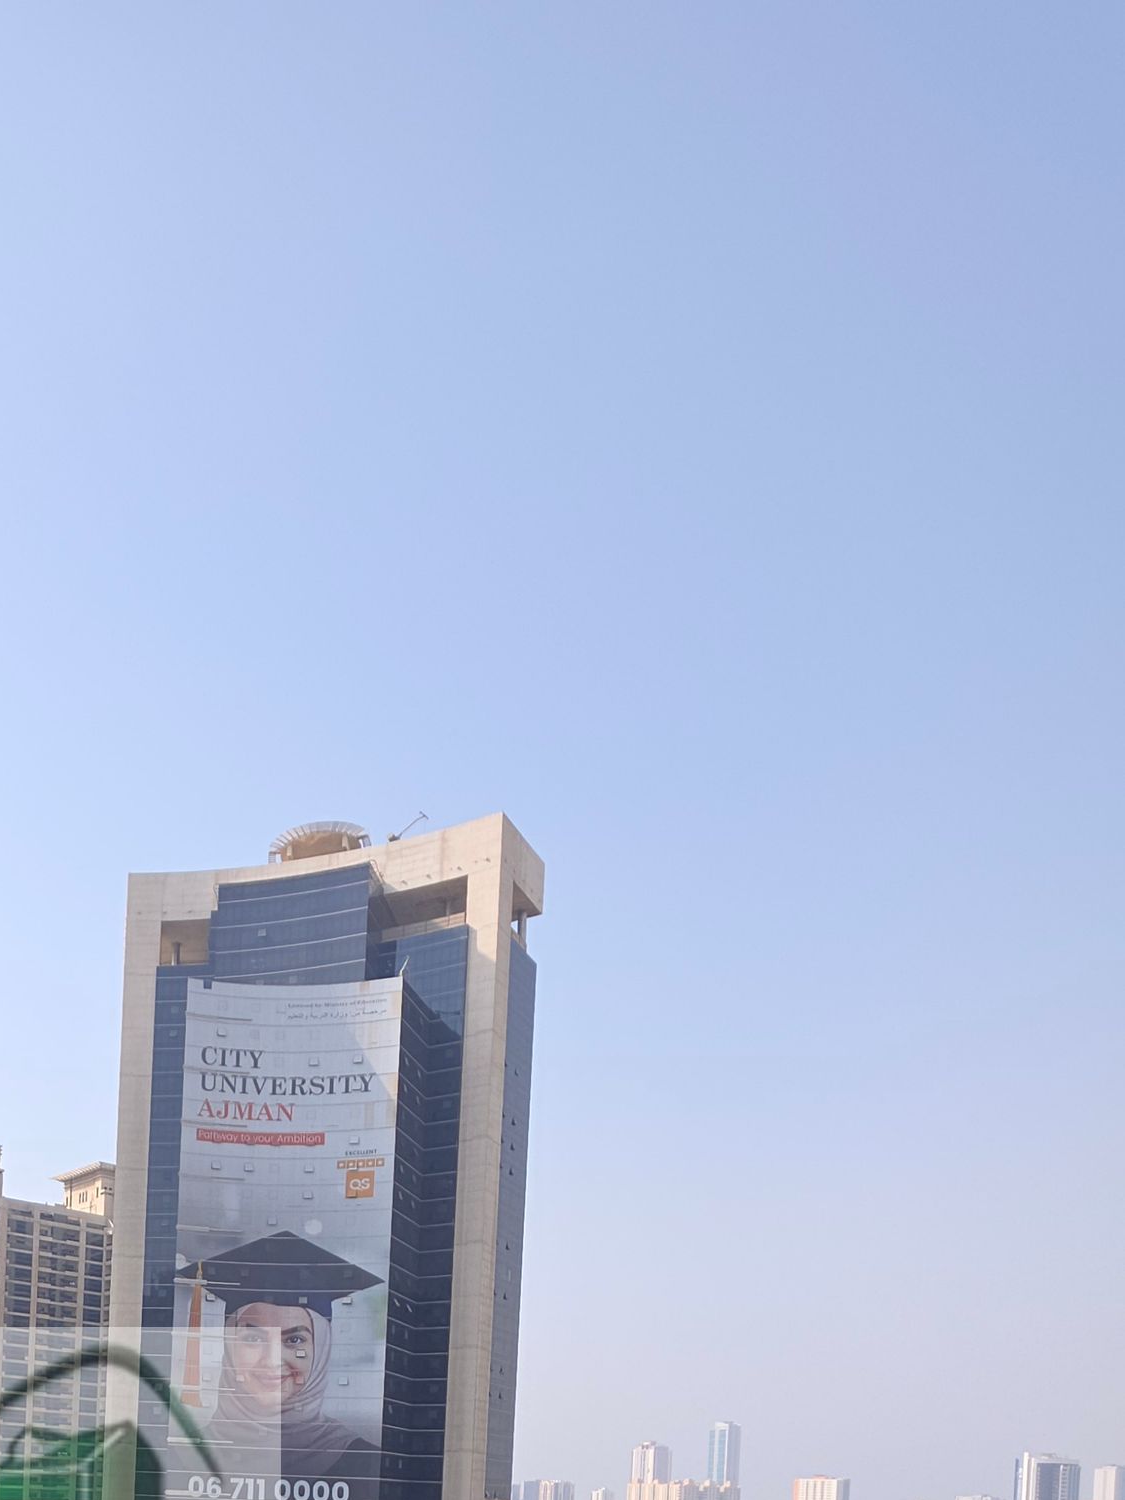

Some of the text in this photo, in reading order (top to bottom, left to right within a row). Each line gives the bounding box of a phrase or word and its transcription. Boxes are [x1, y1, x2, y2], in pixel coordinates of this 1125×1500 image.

[201, 1046, 265, 1069] CITY
[199, 1071, 377, 1096] UNIVERSITY
[197, 1098, 296, 1122] AJMAN
[198, 1130, 322, 1144] Pathway to your Ambition
[349, 1177, 371, 1191] QS
[188, 1475, 223, 1499] 06
[230, 1477, 266, 1500] 711
